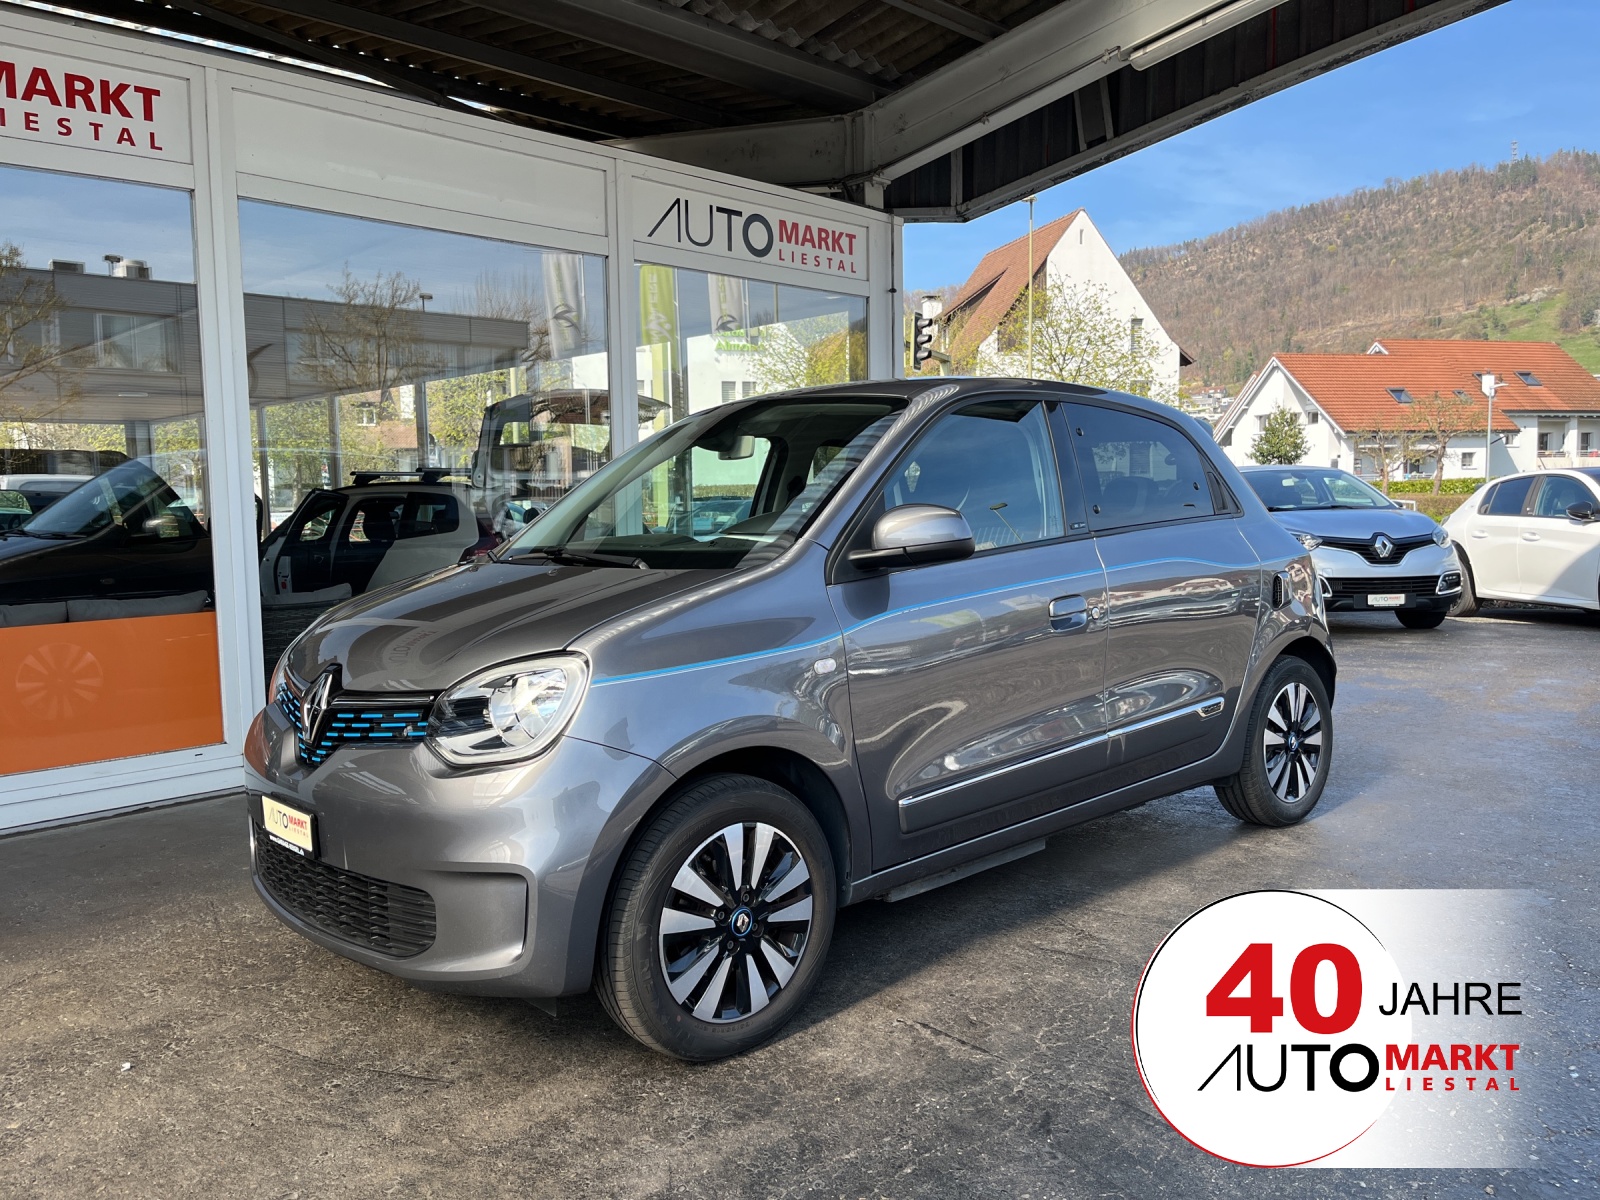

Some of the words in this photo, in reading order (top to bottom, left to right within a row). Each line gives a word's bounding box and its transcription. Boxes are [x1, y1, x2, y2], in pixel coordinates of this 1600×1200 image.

[647, 198, 774, 258] AUTO
[778, 219, 857, 256] MARKT
[779, 249, 857, 274] LIESTAL
